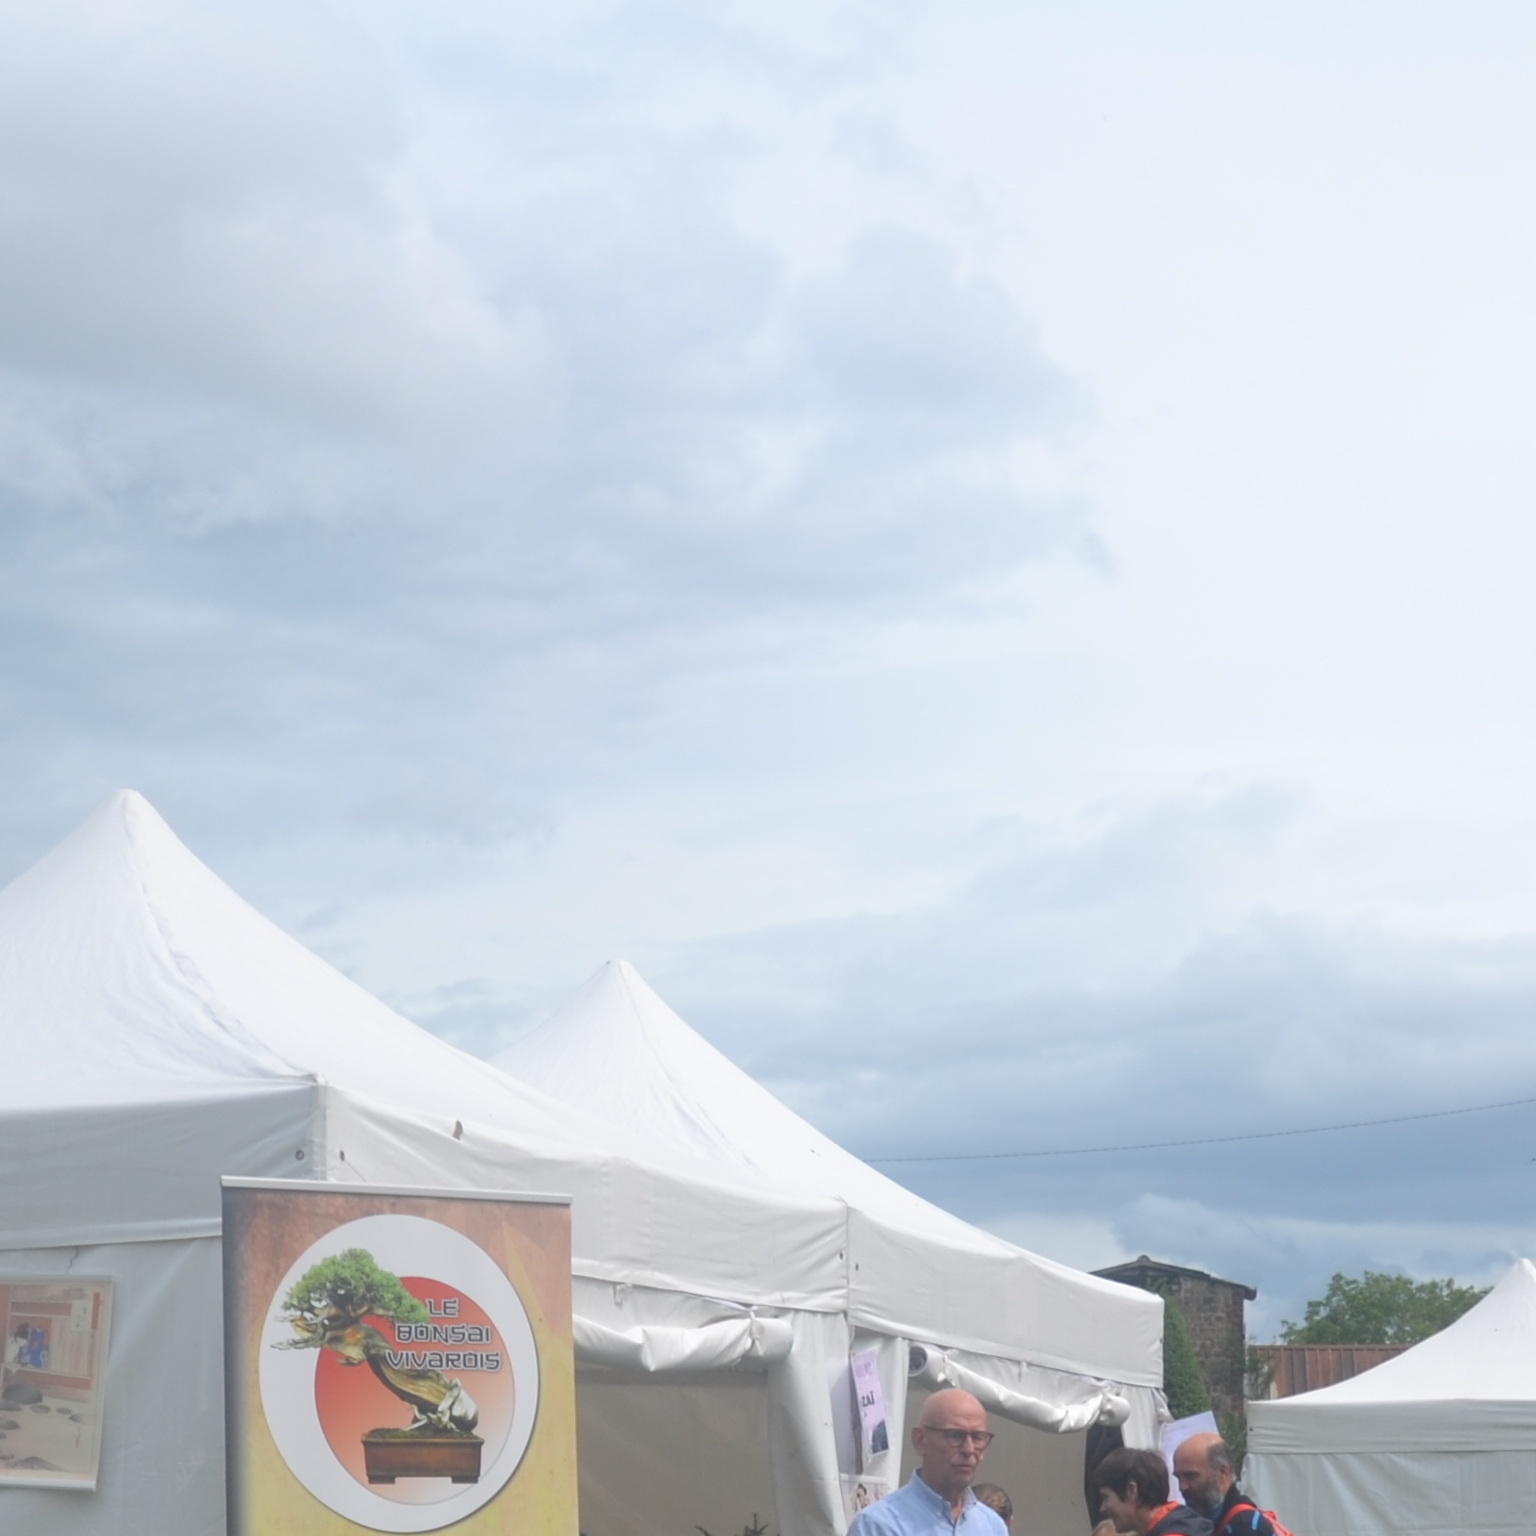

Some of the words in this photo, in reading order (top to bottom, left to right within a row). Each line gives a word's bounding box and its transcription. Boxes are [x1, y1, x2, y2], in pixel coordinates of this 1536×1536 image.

[427, 1299, 458, 1317] LE
[396, 1324, 491, 1344] BONSAI
[385, 1350, 501, 1371] VIVAROIS
